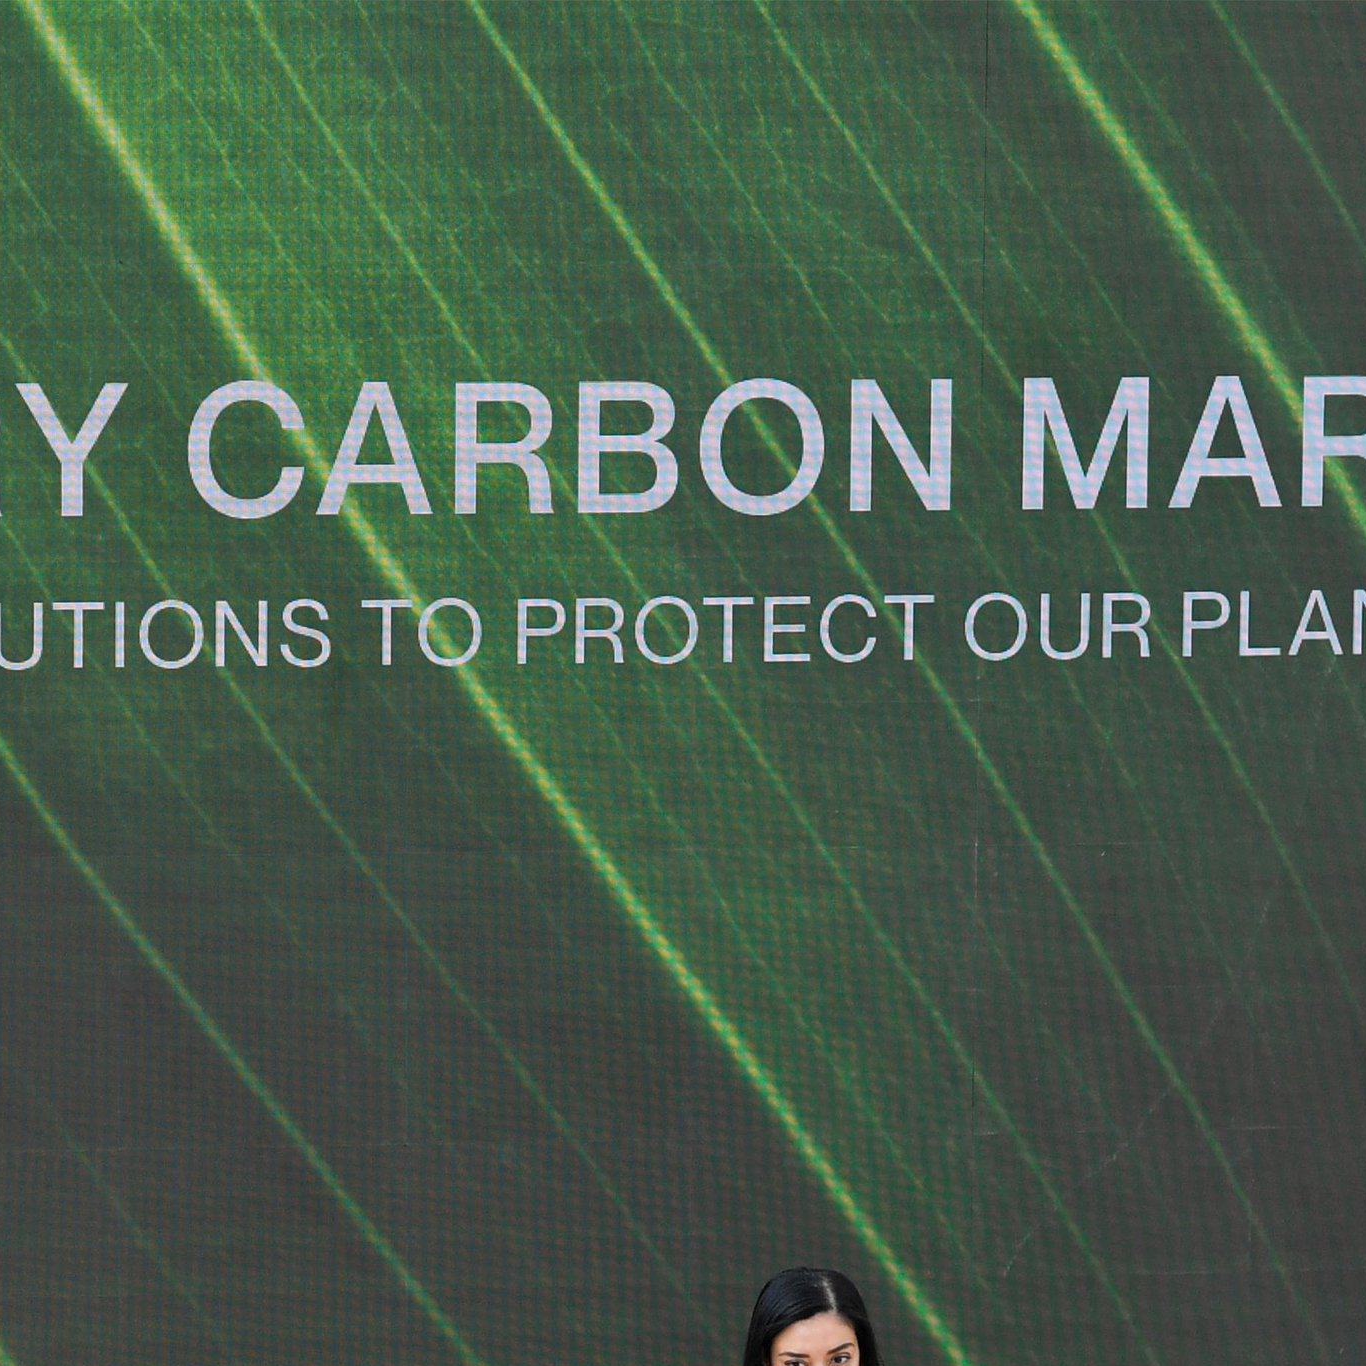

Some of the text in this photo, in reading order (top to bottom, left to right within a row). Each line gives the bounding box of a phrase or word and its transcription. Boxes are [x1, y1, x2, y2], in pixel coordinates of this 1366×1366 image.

[187, 377, 953, 519] CARBON
[361, 597, 482, 667] TO
[517, 594, 935, 665] PROTECT
[964, 592, 1151, 663] OUR
